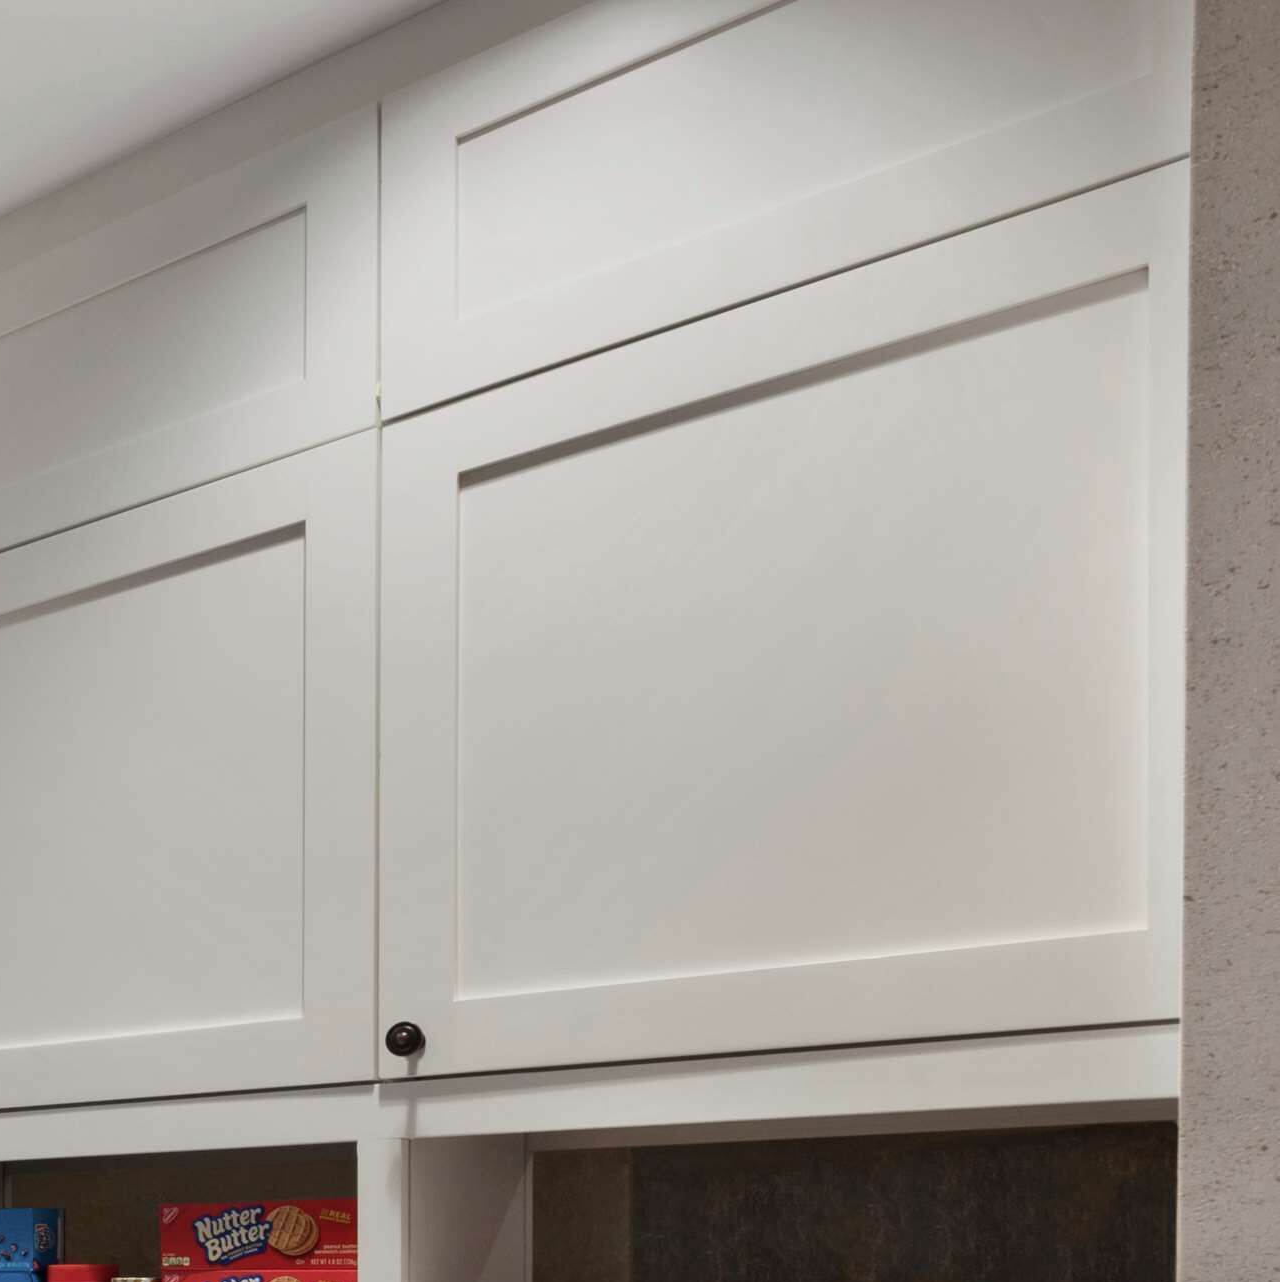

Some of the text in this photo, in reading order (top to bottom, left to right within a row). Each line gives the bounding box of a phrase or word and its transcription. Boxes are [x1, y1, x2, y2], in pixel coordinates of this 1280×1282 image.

[194, 1207, 262, 1244] Nutter
[329, 1210, 351, 1220] REAL
[205, 1222, 270, 1262] Butter
